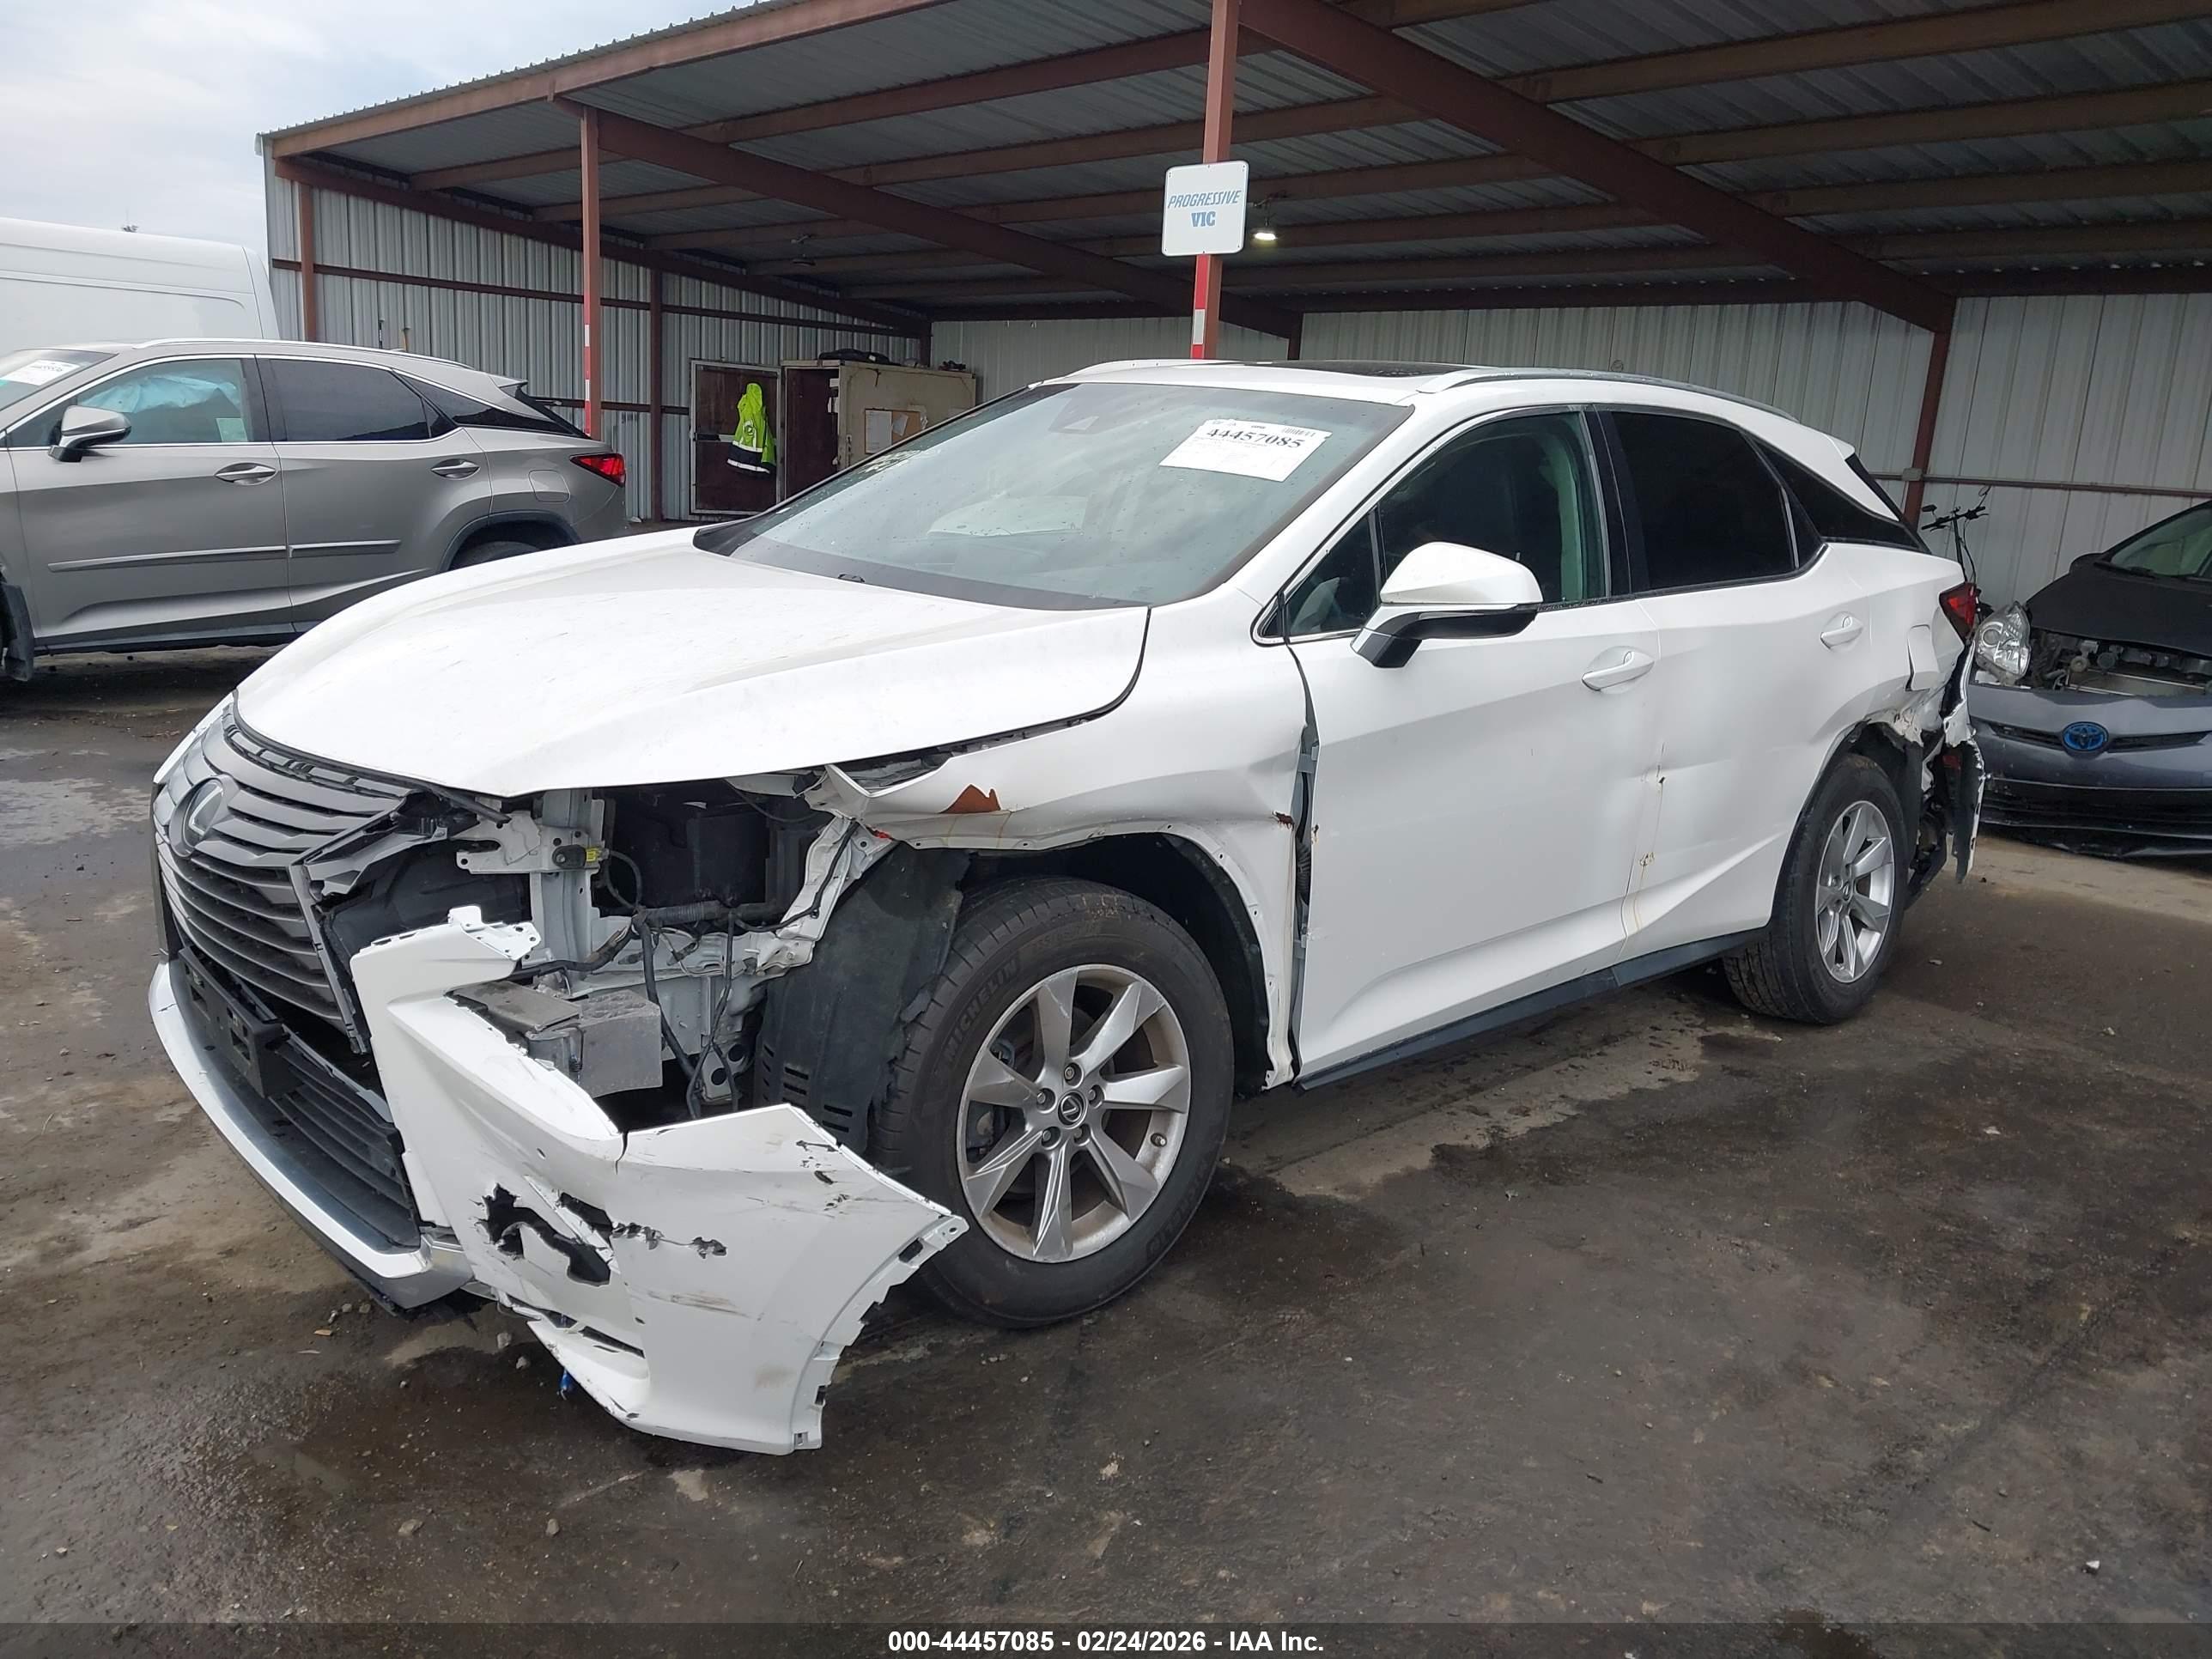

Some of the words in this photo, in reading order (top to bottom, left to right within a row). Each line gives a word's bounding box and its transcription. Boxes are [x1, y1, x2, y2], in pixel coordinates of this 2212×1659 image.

[1168, 190, 1242, 209] PROGRESSIVE
[1191, 210, 1216, 228] VIC
[1206, 428, 1306, 448] 44457085
[945, 958, 1020, 1061] MICHELIN
